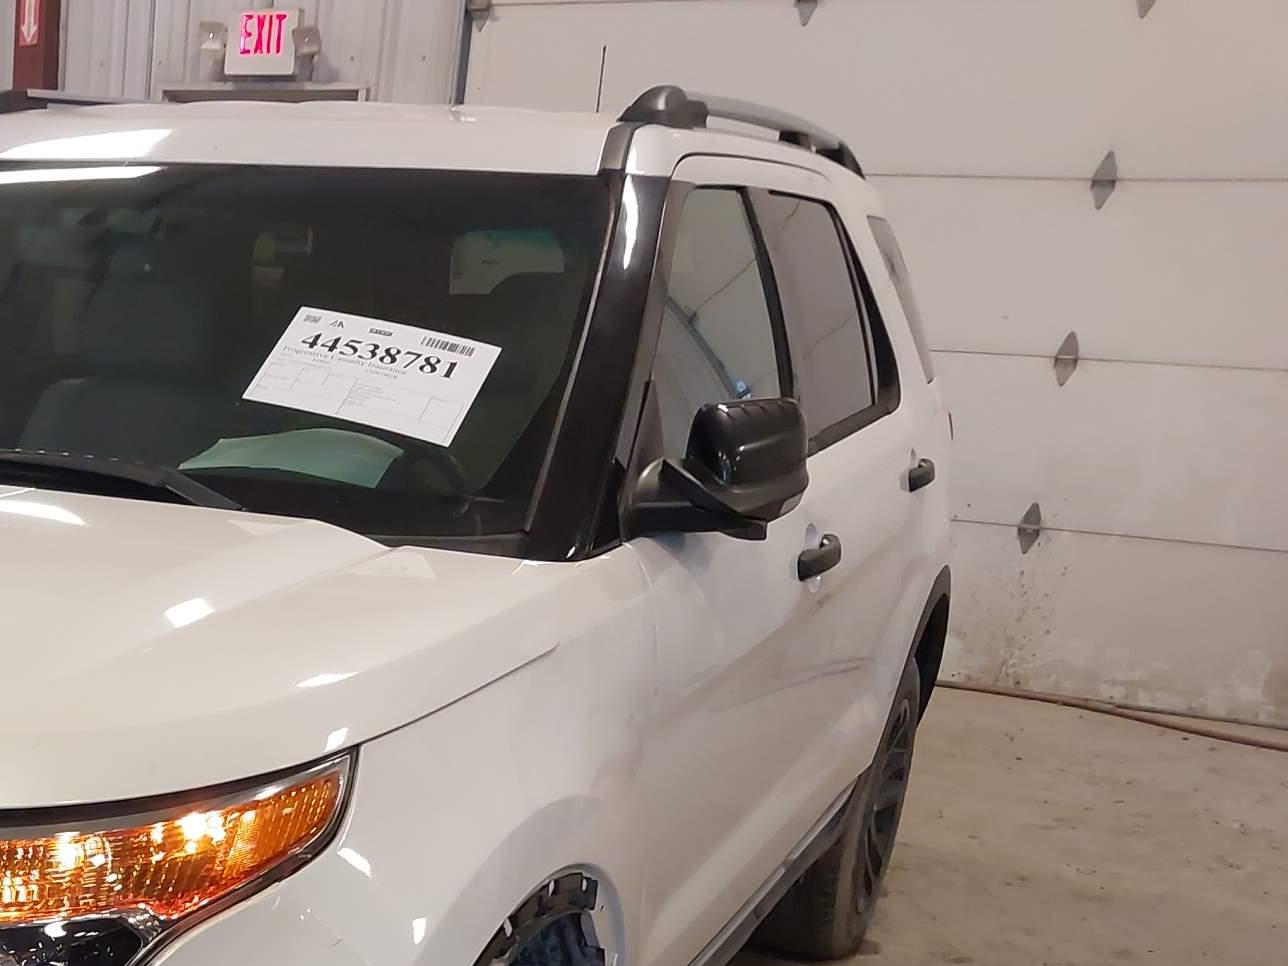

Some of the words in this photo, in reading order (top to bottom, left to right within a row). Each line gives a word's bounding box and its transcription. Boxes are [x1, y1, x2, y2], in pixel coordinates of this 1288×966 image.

[239, 13, 288, 55] EXIT
[281, 344, 329, 360] Progressive
[300, 332, 459, 379] 44538781
